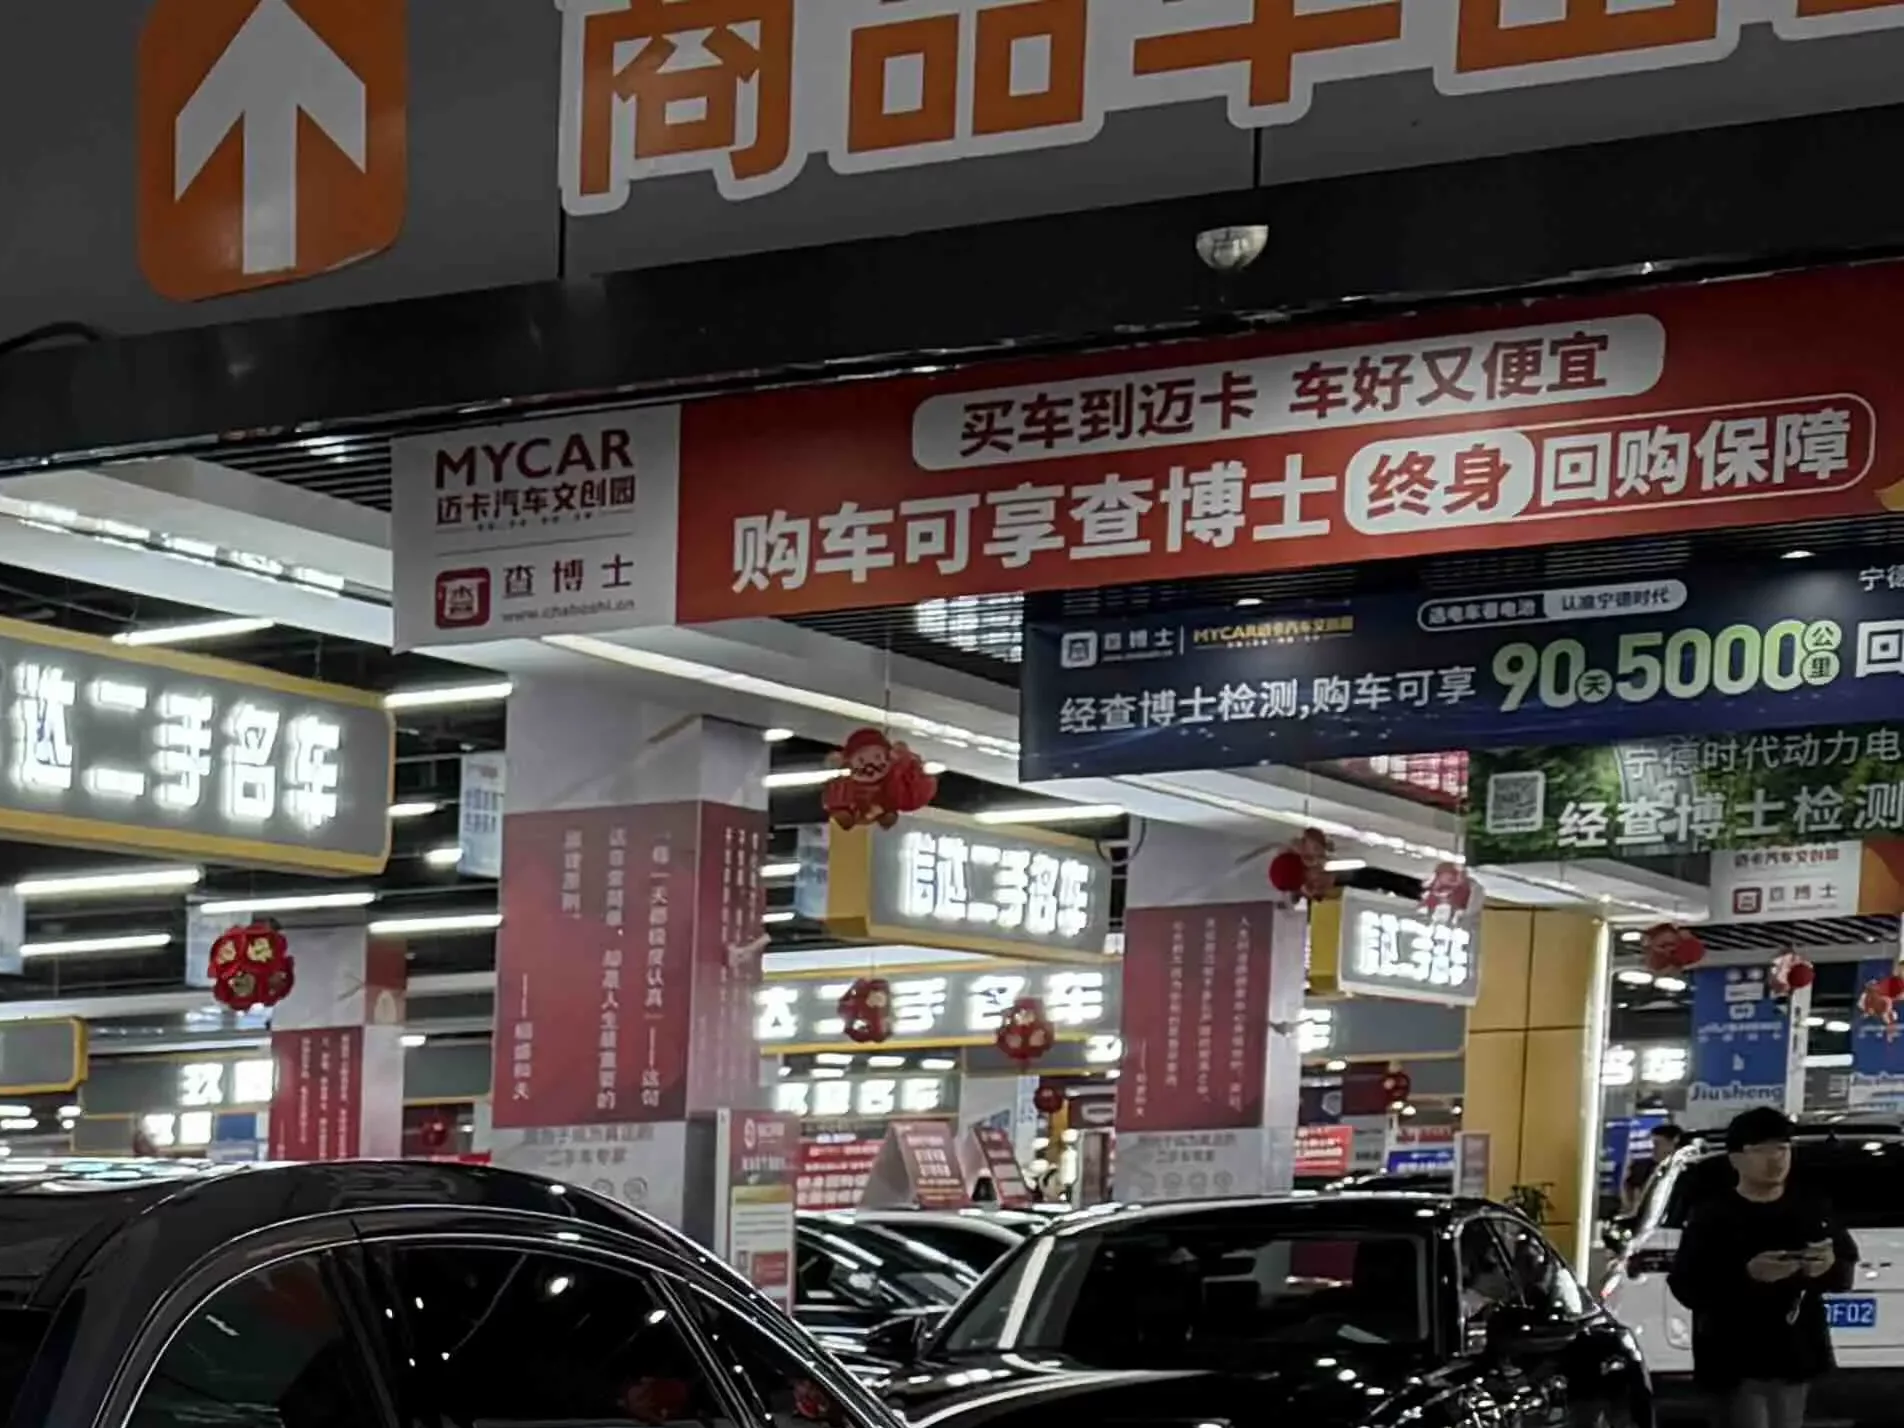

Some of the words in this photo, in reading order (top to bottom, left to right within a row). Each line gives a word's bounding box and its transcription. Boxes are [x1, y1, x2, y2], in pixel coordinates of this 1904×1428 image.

[958, 369, 1258, 458] 买车到迈卡
[1289, 330, 1610, 420] 车好又便宜
[435, 428, 634, 490] MYCAR
[436, 474, 635, 526] 迈卡汽车文创园
[502, 553, 634, 599] 查博士
[1059, 665, 1477, 735] 经查博士检测,购车可享
[1556, 781, 1904, 849] 经查博士检测
[897, 831, 1090, 938] 信达二手名车
